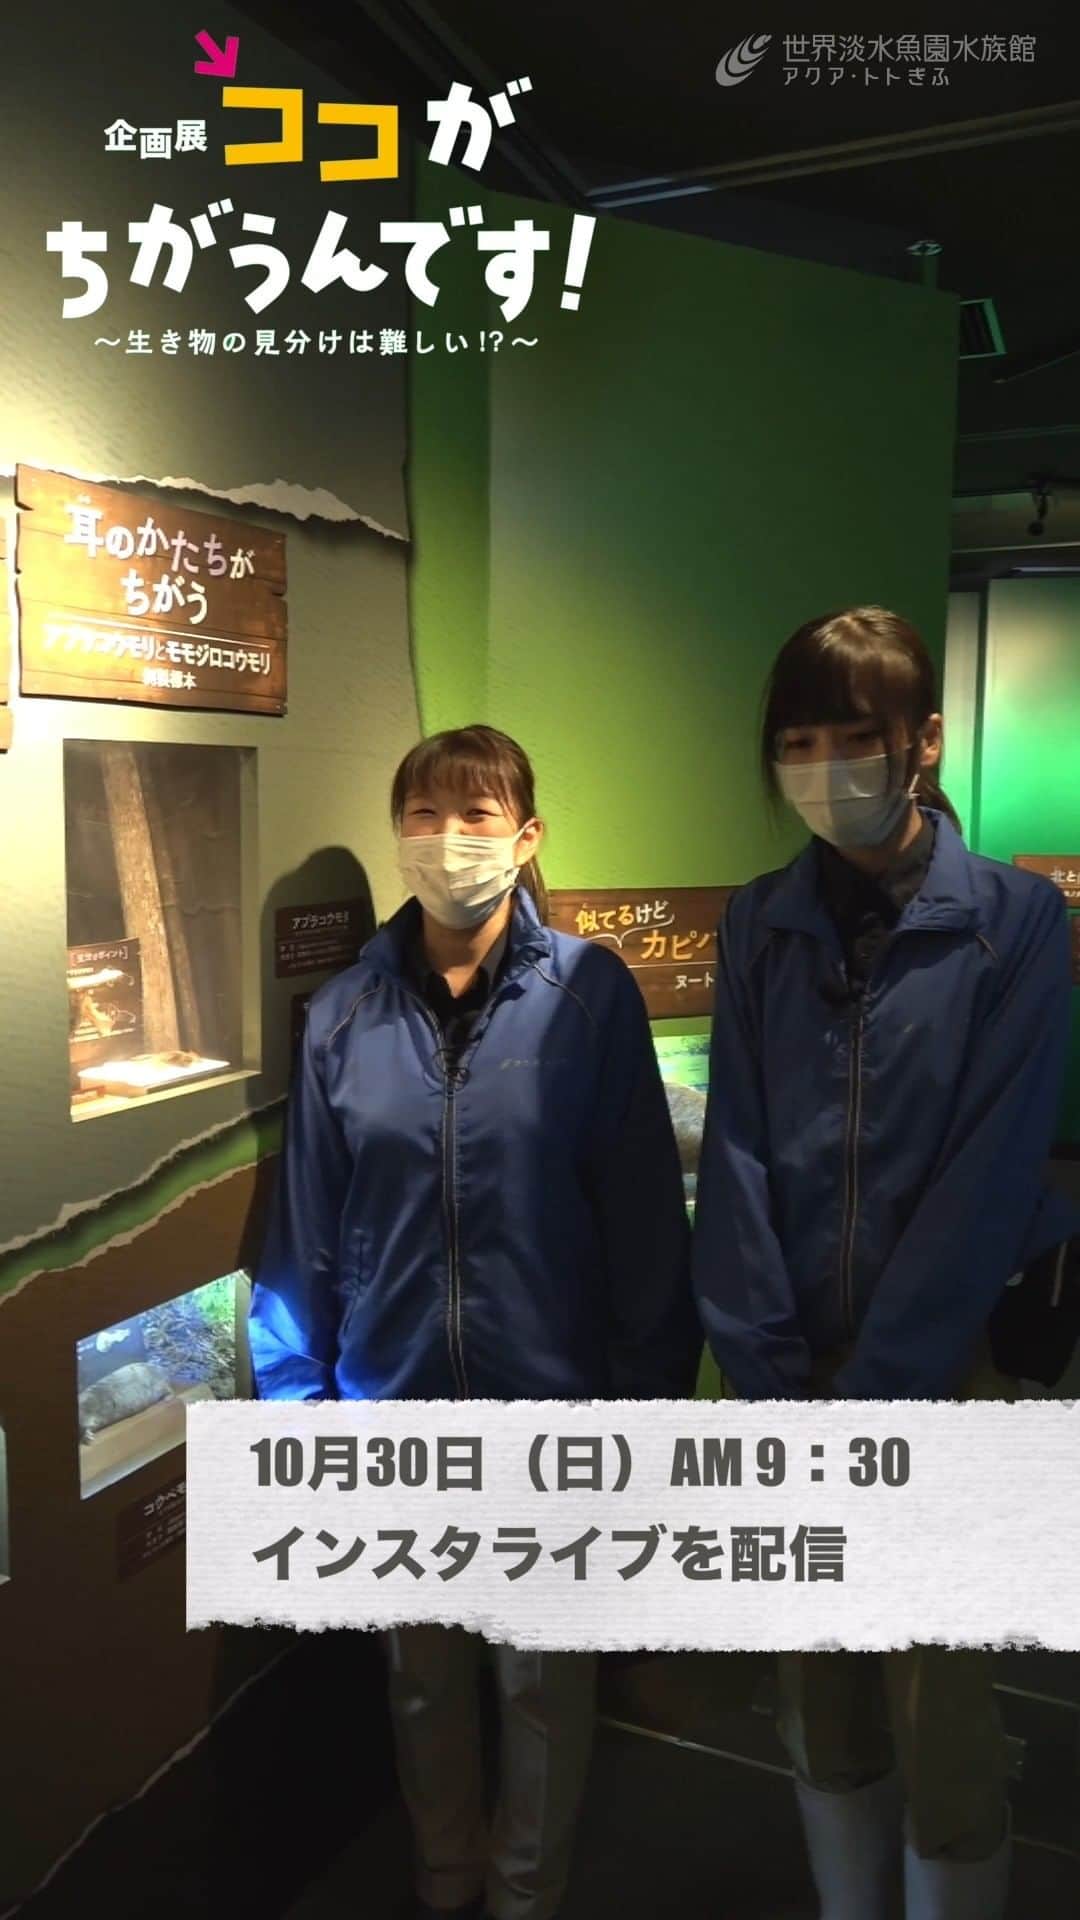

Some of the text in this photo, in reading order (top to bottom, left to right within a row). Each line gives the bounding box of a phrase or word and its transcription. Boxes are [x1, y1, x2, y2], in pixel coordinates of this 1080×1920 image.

[64, 496, 255, 579] 耳のかたちが
[120, 568, 208, 625] ちがう
[575, 900, 669, 935] 似てるけど
[675, 971, 715, 990] ヌート
